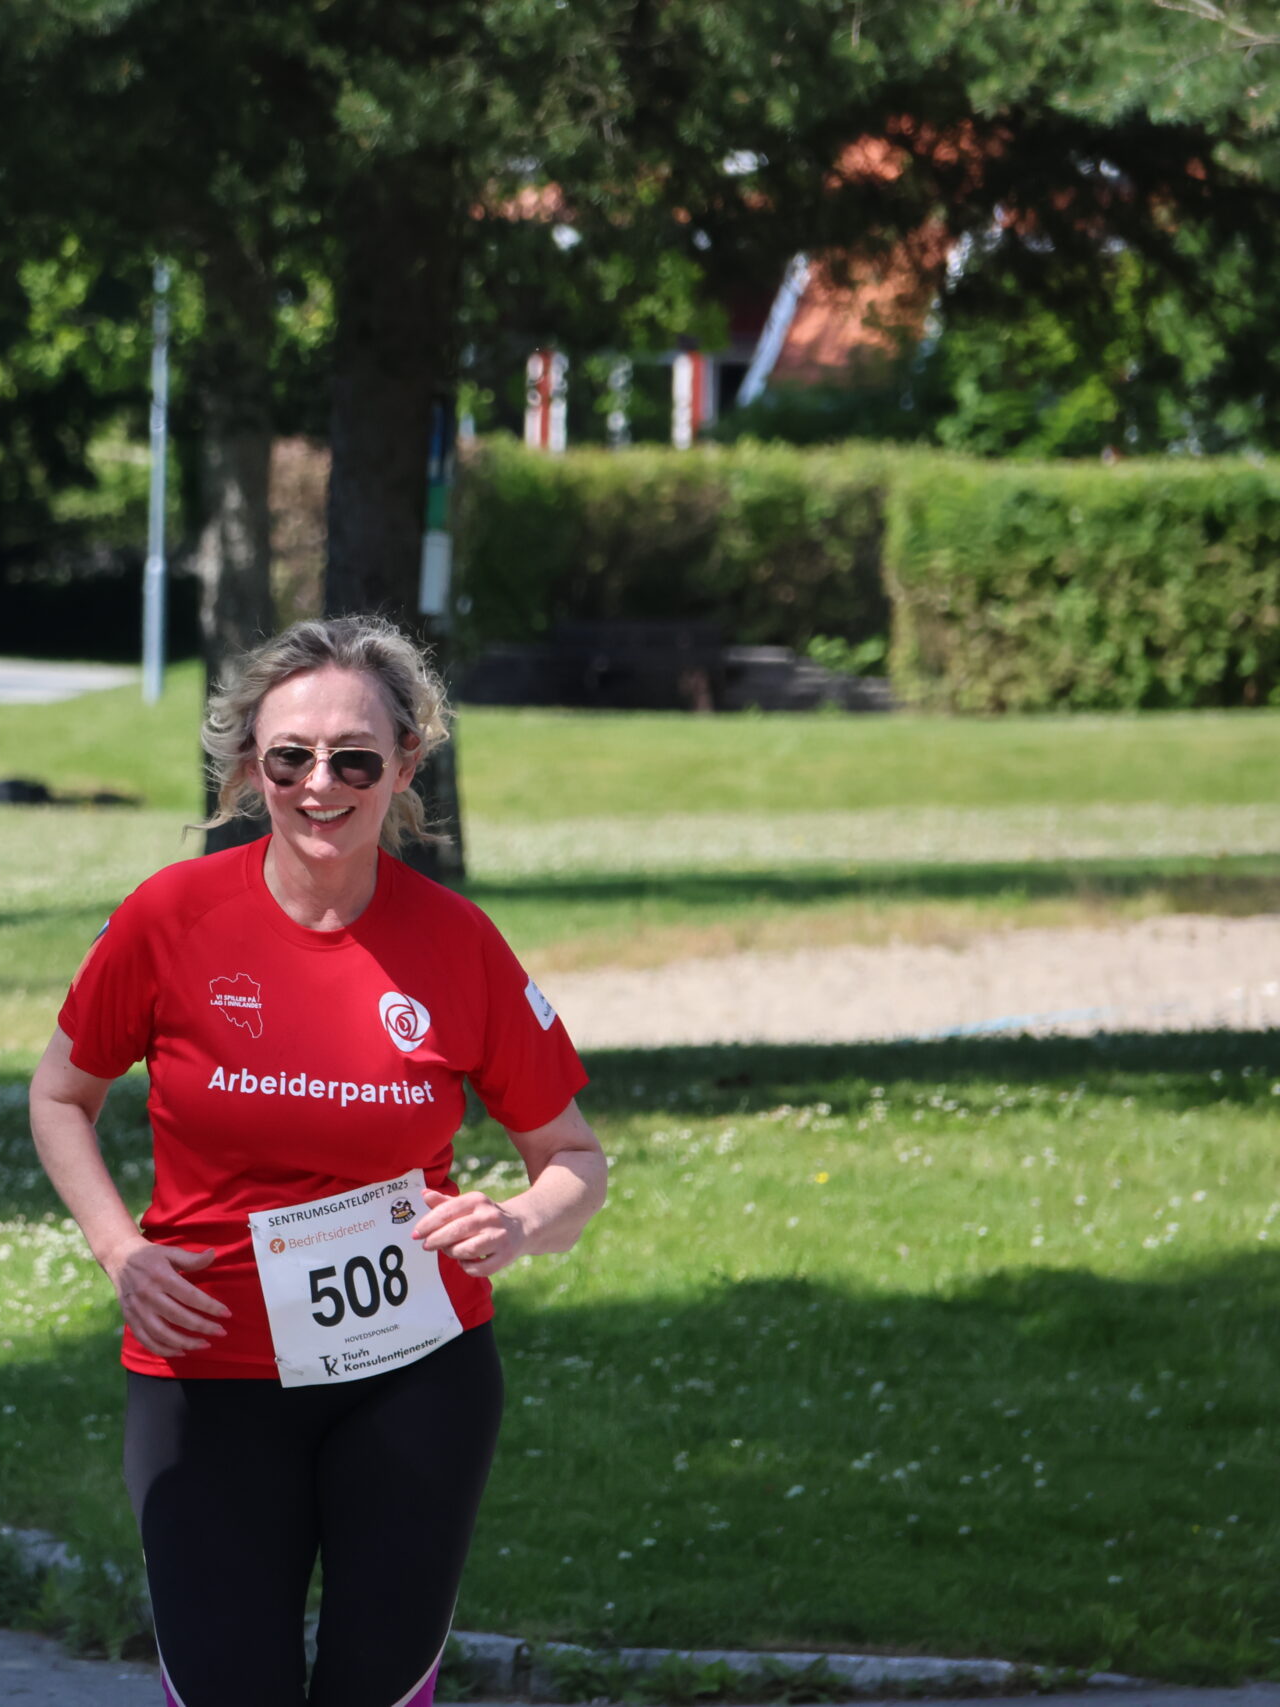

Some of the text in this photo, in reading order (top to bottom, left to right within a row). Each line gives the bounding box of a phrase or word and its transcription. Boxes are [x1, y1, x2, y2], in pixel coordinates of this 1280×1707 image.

[208, 1067, 435, 1107] Arbeiderpartiet
[268, 1179, 409, 1227] SENTRUMSGATELØPET 2025
[289, 1218, 376, 1249] Bedriftsidretten
[308, 1244, 408, 1327] 508
[344, 1323, 400, 1344] HOVEDSPONSOR:
